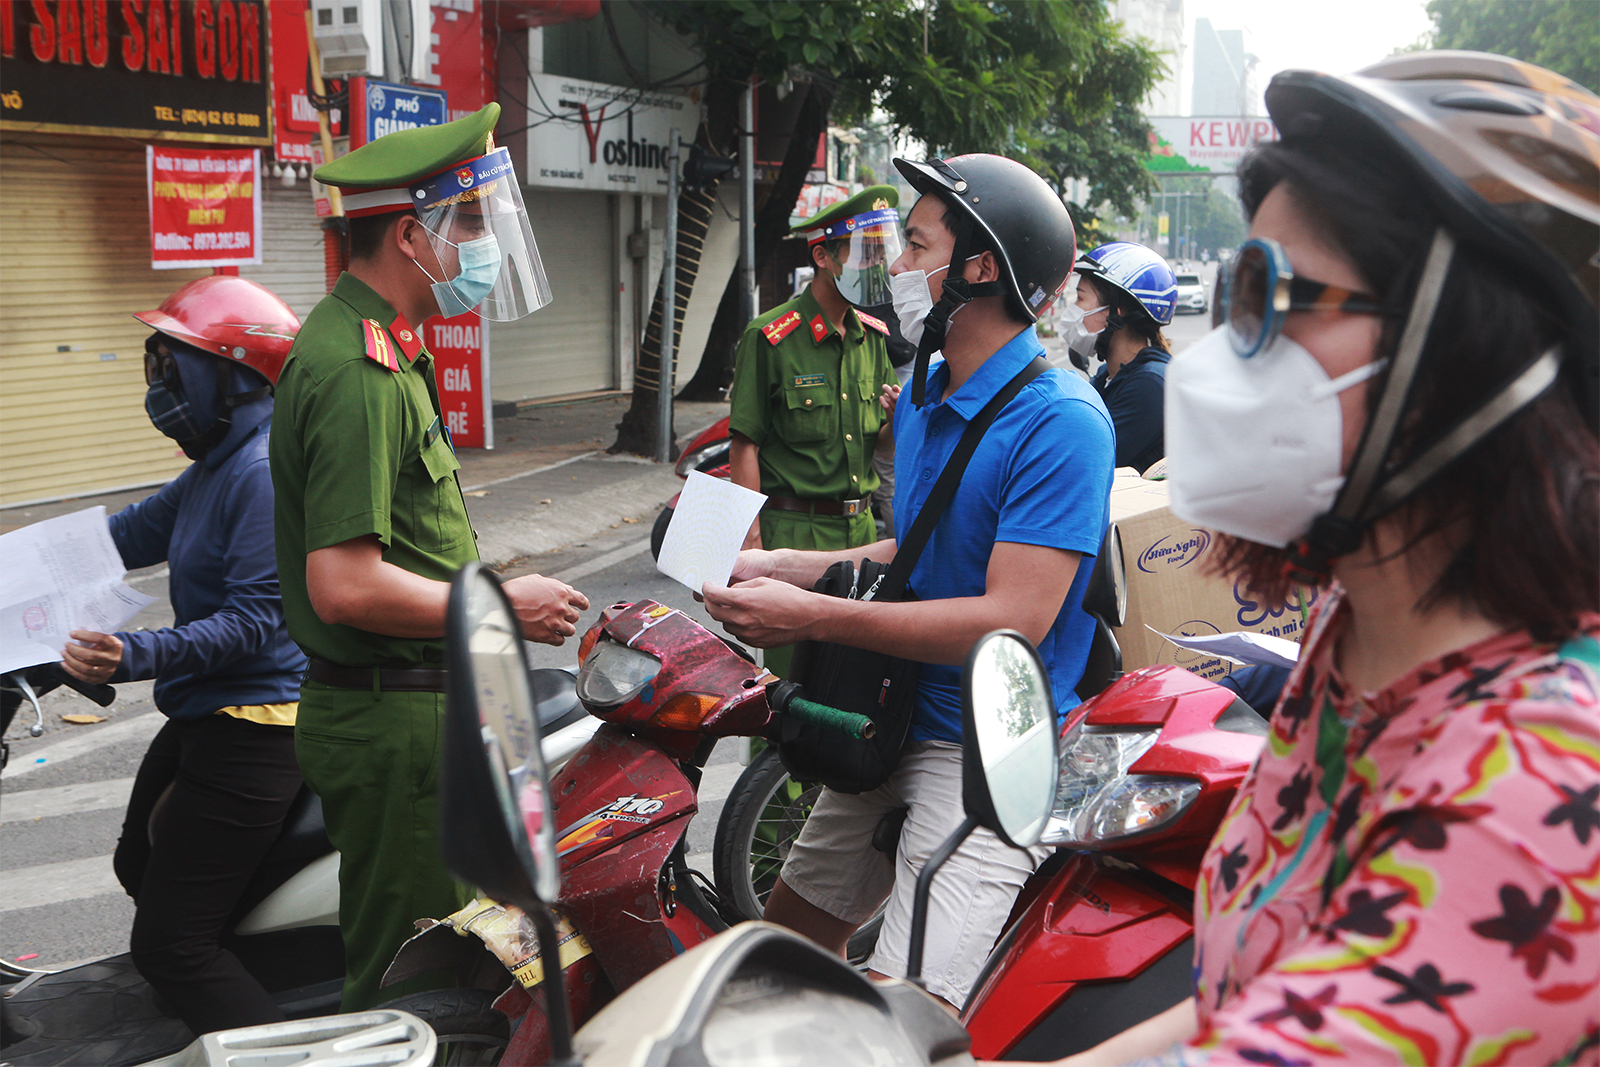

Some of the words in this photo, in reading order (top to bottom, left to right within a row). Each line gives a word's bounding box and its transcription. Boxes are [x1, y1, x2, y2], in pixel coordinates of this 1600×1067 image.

[395, 96, 420, 113] PHỐ
[374, 110, 418, 140] GIẢ
[433, 325, 480, 354] THOẠI
[444, 364, 471, 392] GIÁ
[447, 402, 468, 434] RẺ
[1167, 554, 1185, 564] Food
[607, 795, 665, 815] 110
[518, 969, 537, 984] TH
